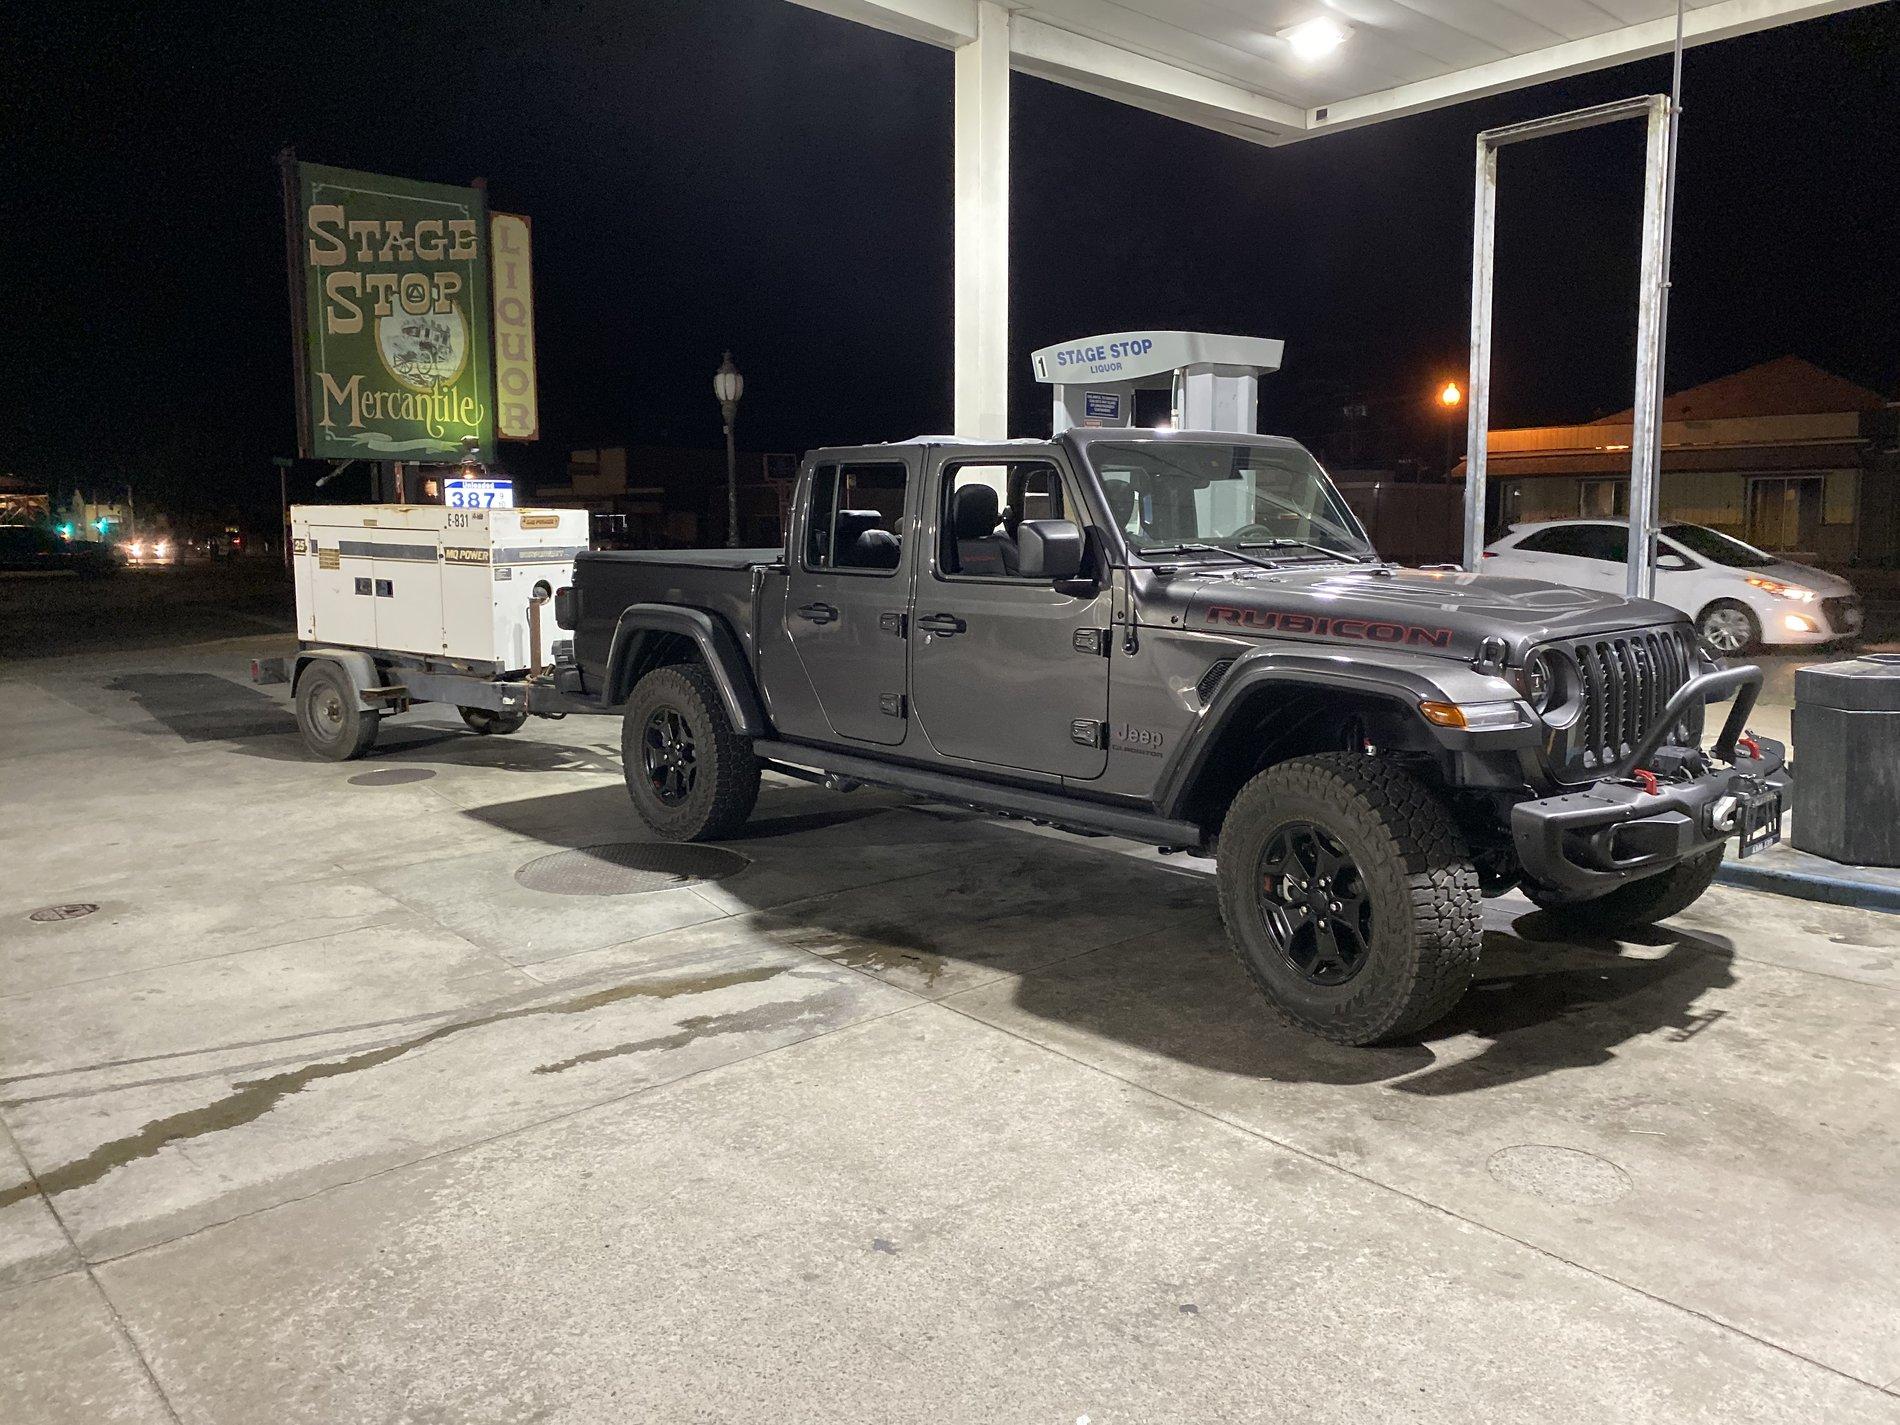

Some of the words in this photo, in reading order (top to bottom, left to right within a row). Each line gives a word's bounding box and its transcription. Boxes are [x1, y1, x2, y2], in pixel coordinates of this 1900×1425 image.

[308, 204, 478, 266] STAGE
[326, 271, 462, 335] STOP
[497, 224, 531, 430] LIQUOR
[1057, 346, 1106, 366] STAGE
[1110, 339, 1152, 359] STOP
[1038, 357, 1046, 377] 1
[1090, 362, 1122, 374] LIQUOR
[315, 372, 484, 438] Mercantile
[452, 491, 495, 509] 387
[447, 513, 469, 528] E-831
[445, 549, 459, 560] MQ
[460, 550, 489, 561] POWER
[1206, 606, 1453, 648] RUBICON
[1115, 723, 1163, 749] Jeep
